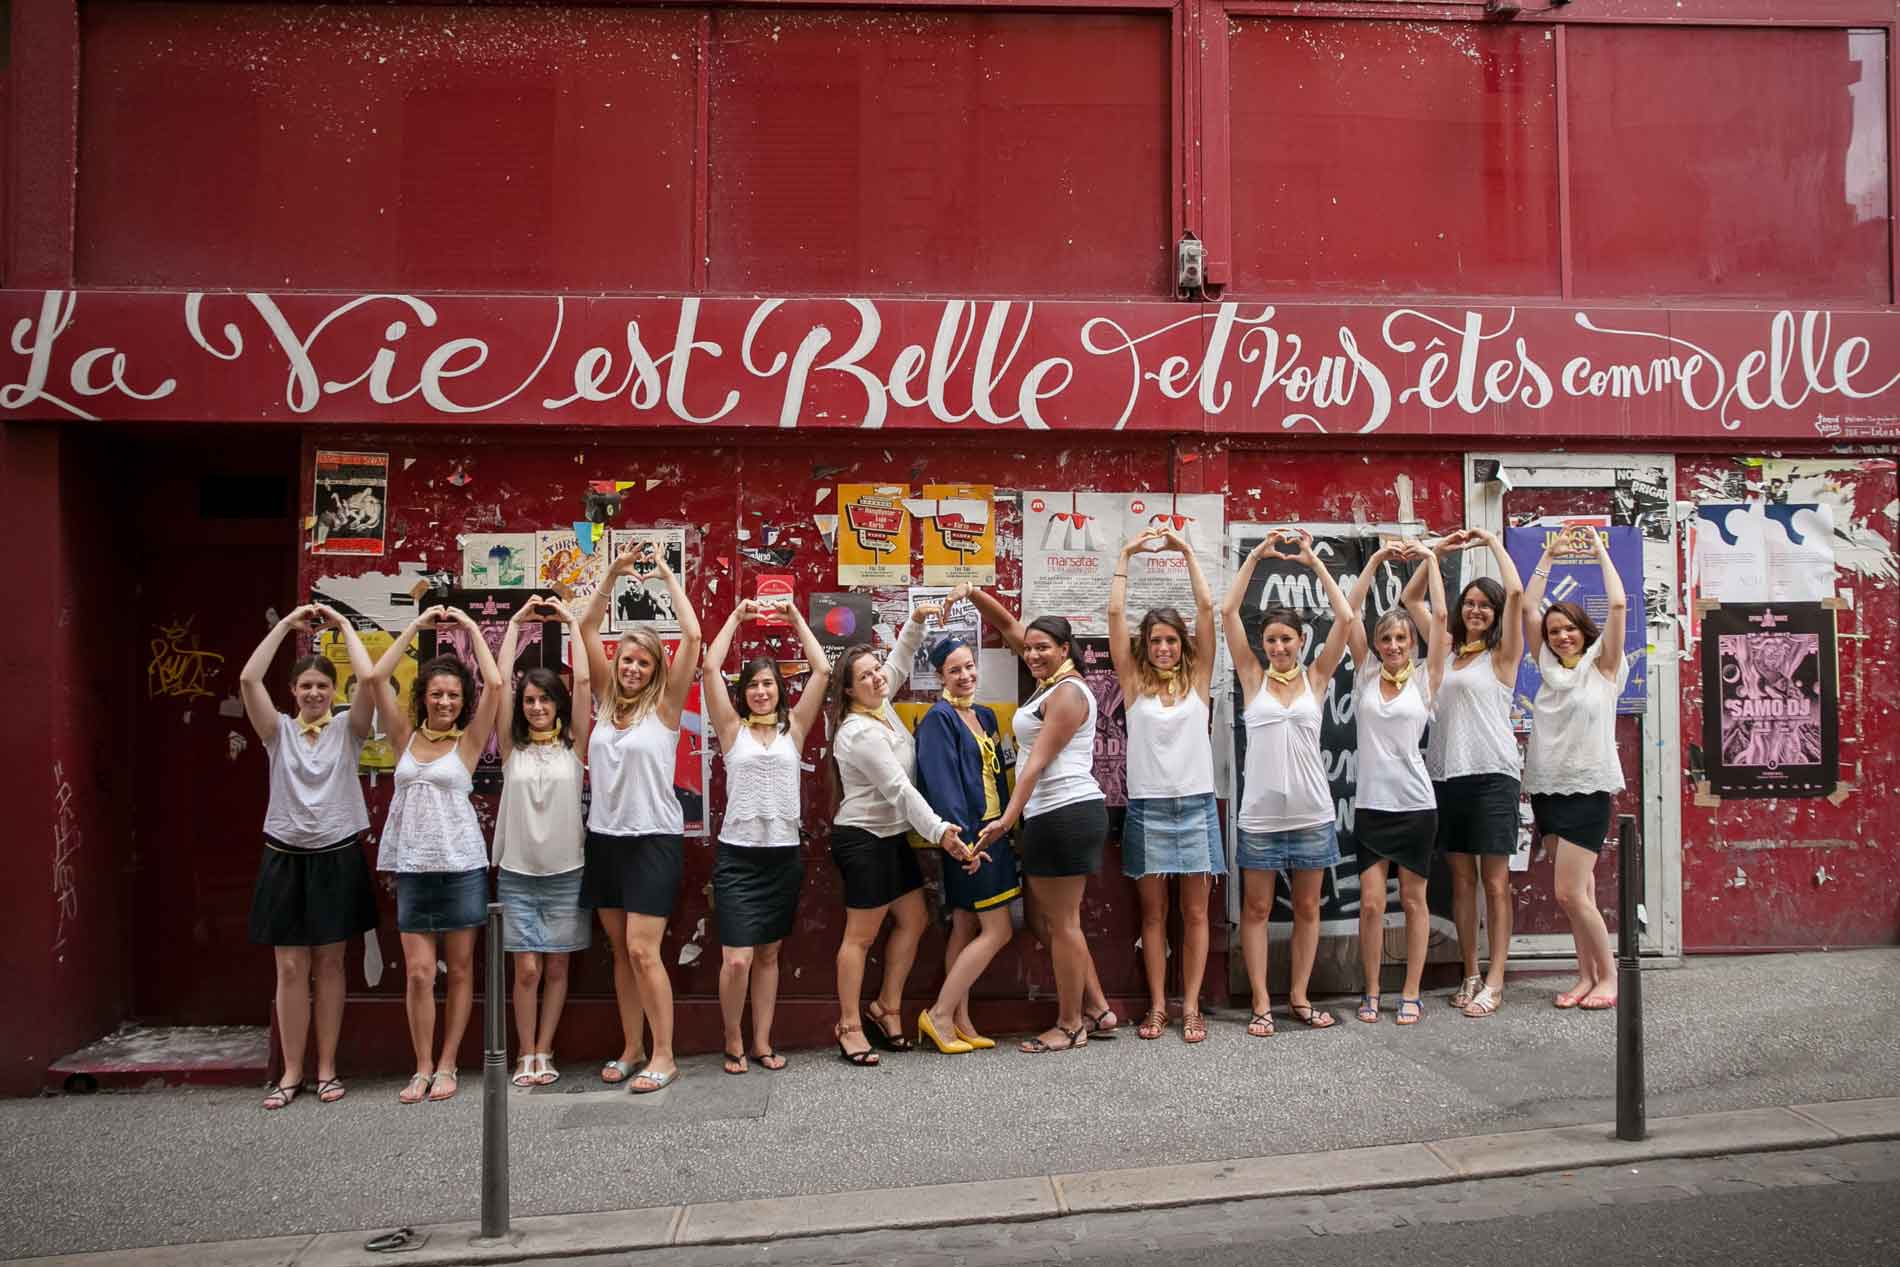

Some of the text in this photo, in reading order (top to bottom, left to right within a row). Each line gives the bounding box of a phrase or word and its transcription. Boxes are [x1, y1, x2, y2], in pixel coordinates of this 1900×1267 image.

[0, 290, 176, 420] La
[184, 290, 567, 414] Vie
[542, 296, 740, 424] est
[741, 297, 1074, 430] Belle
[1238, 325, 1391, 433] Vous
[1382, 305, 1553, 413] êtes
[1561, 312, 1726, 411] comme
[1720, 310, 1900, 429] elle
[1047, 555, 1099, 568] marsatac
[1726, 698, 1812, 718] SAMO DJ
